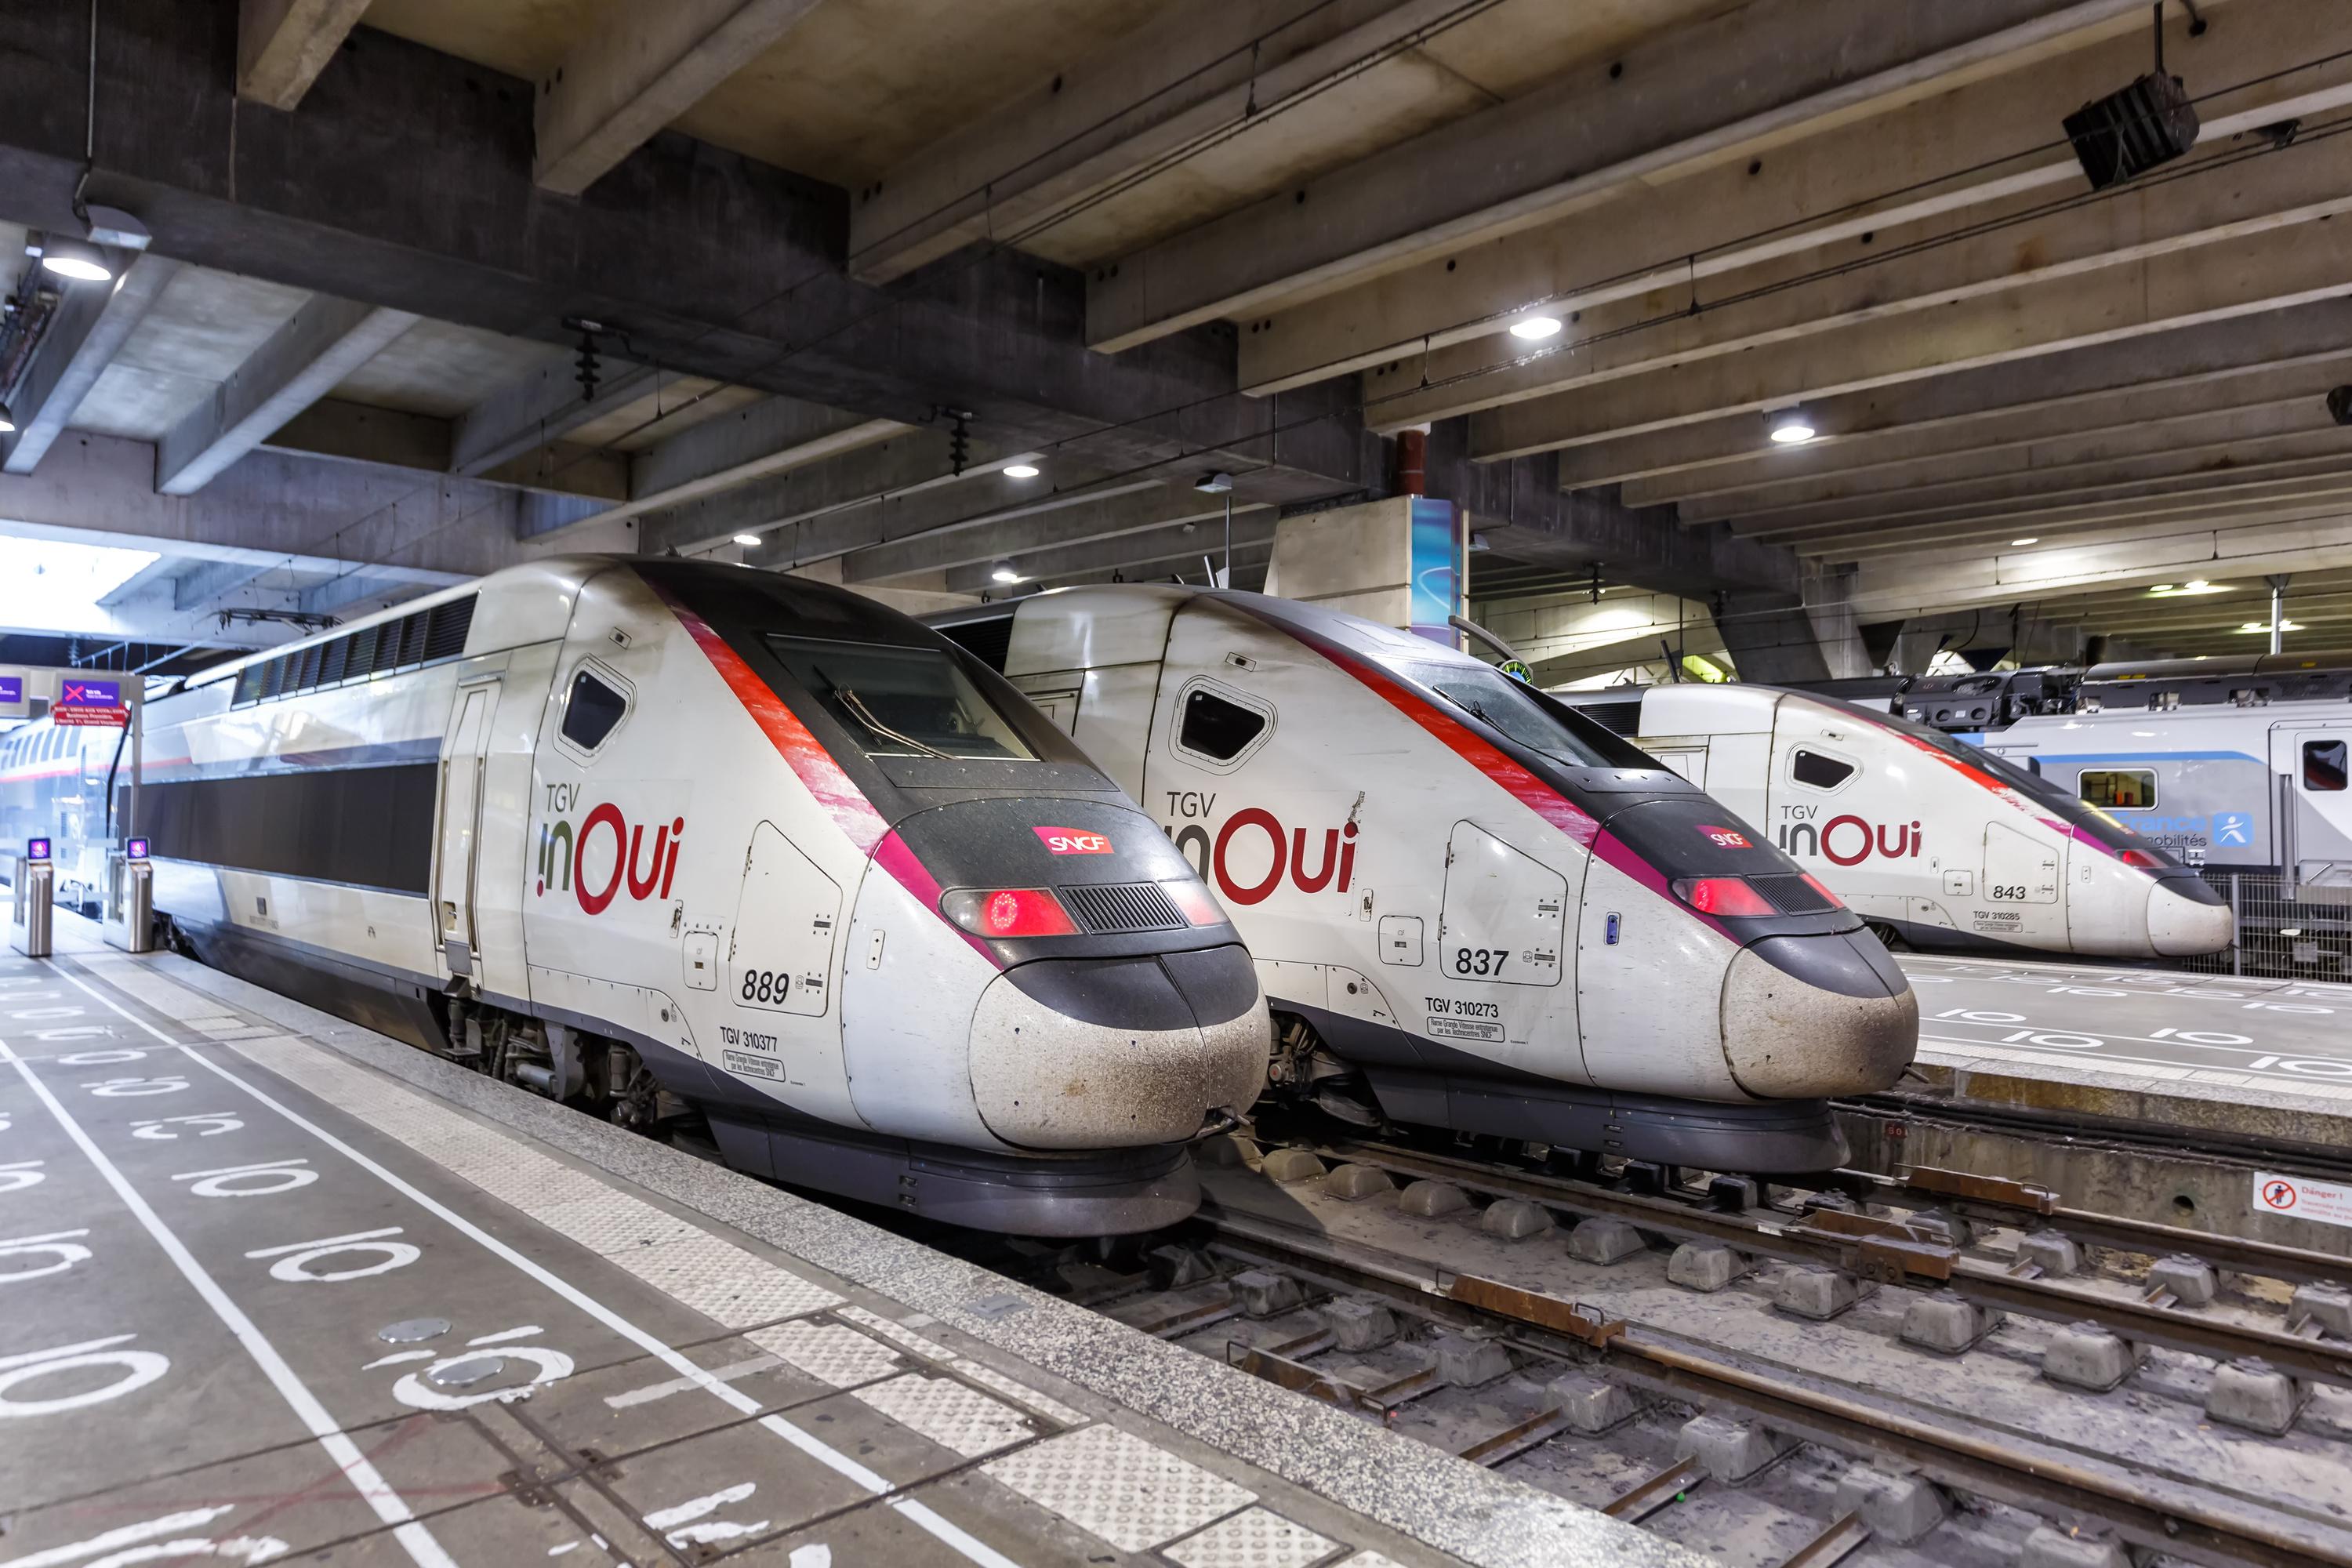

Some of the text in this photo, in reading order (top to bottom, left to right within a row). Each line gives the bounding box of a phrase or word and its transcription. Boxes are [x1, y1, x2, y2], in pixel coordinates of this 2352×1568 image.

[546, 783, 581, 813] TGV
[1167, 791, 1217, 818] TGV
[1780, 805, 1819, 820] TGV
[1048, 837, 1105, 851] SNCF
[1710, 833, 1744, 846] SNCF
[536, 802, 684, 916] inOui
[1164, 808, 1359, 906] nOui
[1993, 885, 2027, 899] 843
[1973, 910, 1989, 919] TGV
[1455, 948, 1510, 977] 837
[742, 969, 790, 1005] 889
[1425, 997, 1499, 1018] TGV 310273
[1936, 1008, 2027, 1022] 10
[2241, 1002, 2335, 1014] 10
[720, 1026, 778, 1052] TGV 310377
[2000, 1031, 2104, 1048] 10
[2149, 1028, 2254, 1044] 10
[2249, 1055, 2352, 1076] 10
